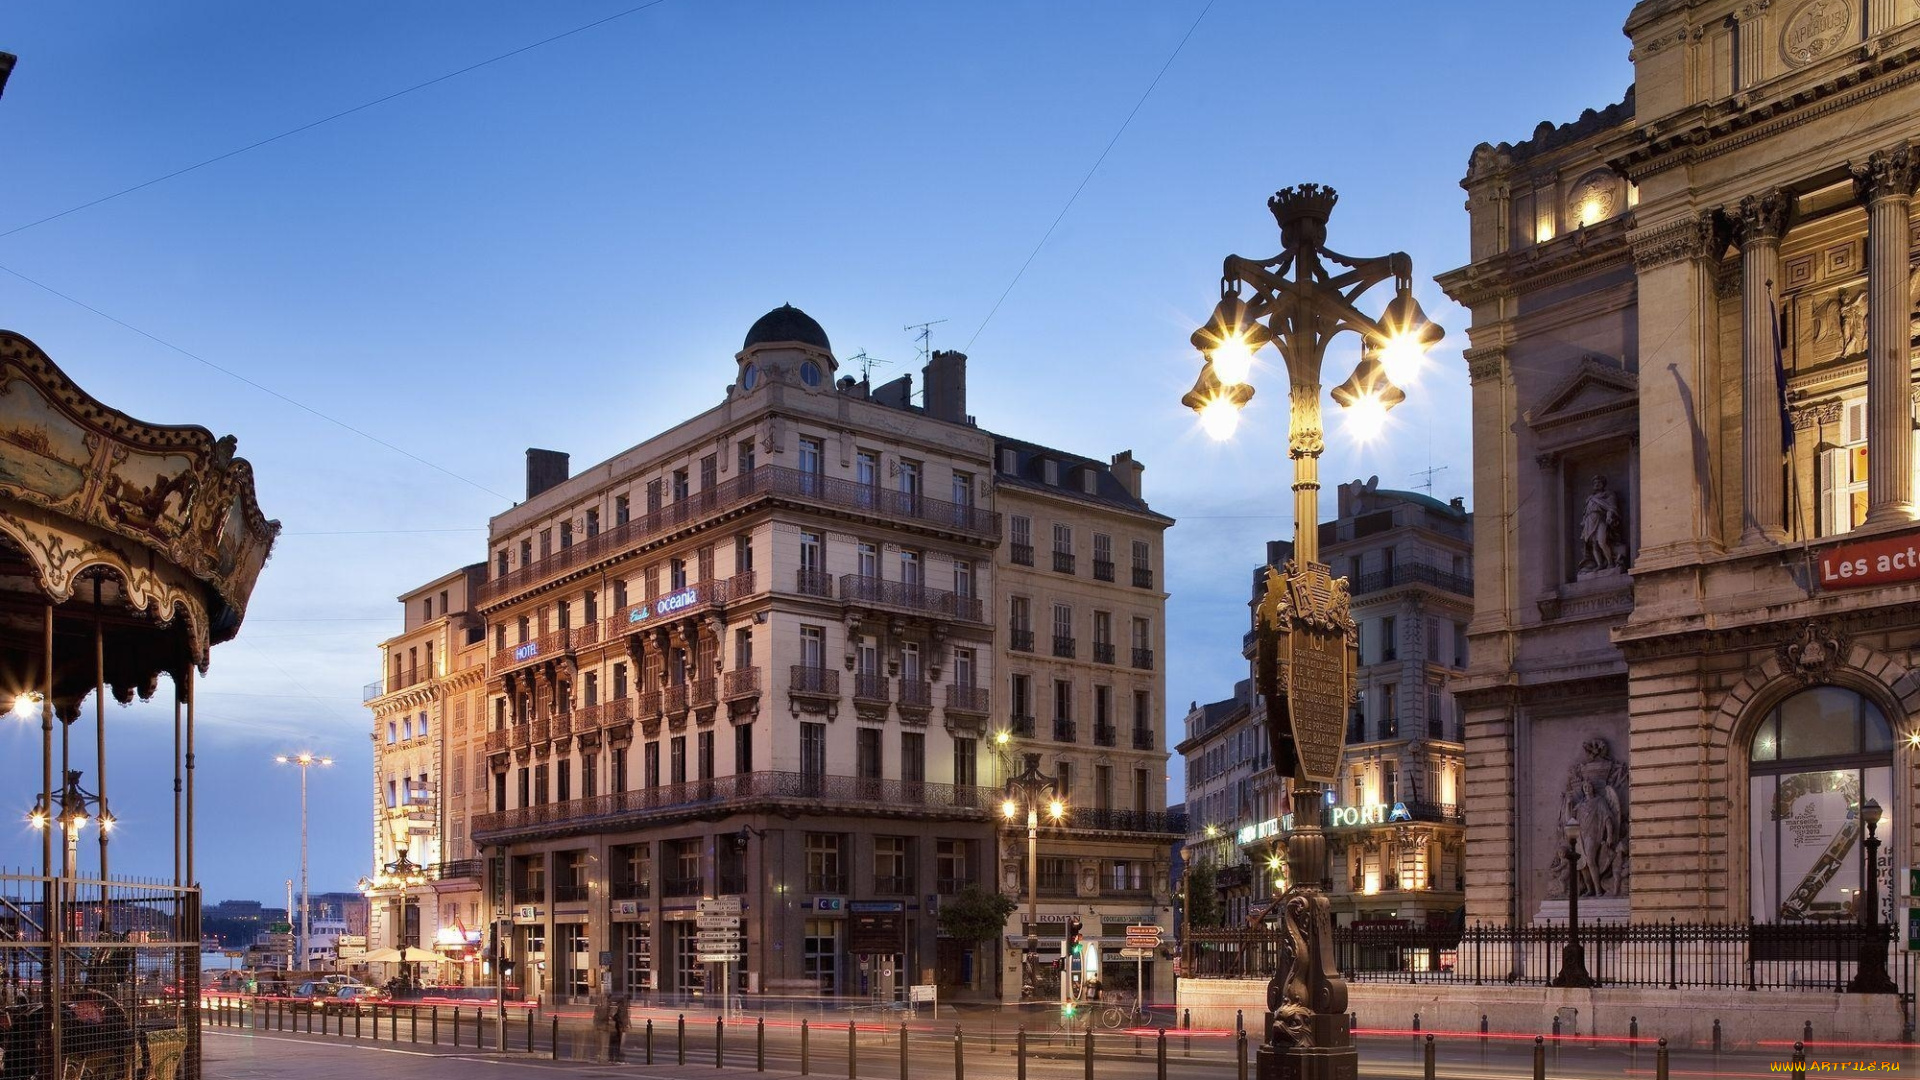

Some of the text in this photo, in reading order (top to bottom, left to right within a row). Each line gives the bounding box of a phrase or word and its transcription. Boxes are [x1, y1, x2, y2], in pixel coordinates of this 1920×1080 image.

[1824, 558, 1868, 581] Les
[657, 588, 698, 614] oceania
[515, 642, 538, 661] HOTEL
[1282, 812, 1295, 832] VIE
[1332, 803, 1389, 827] PORT
